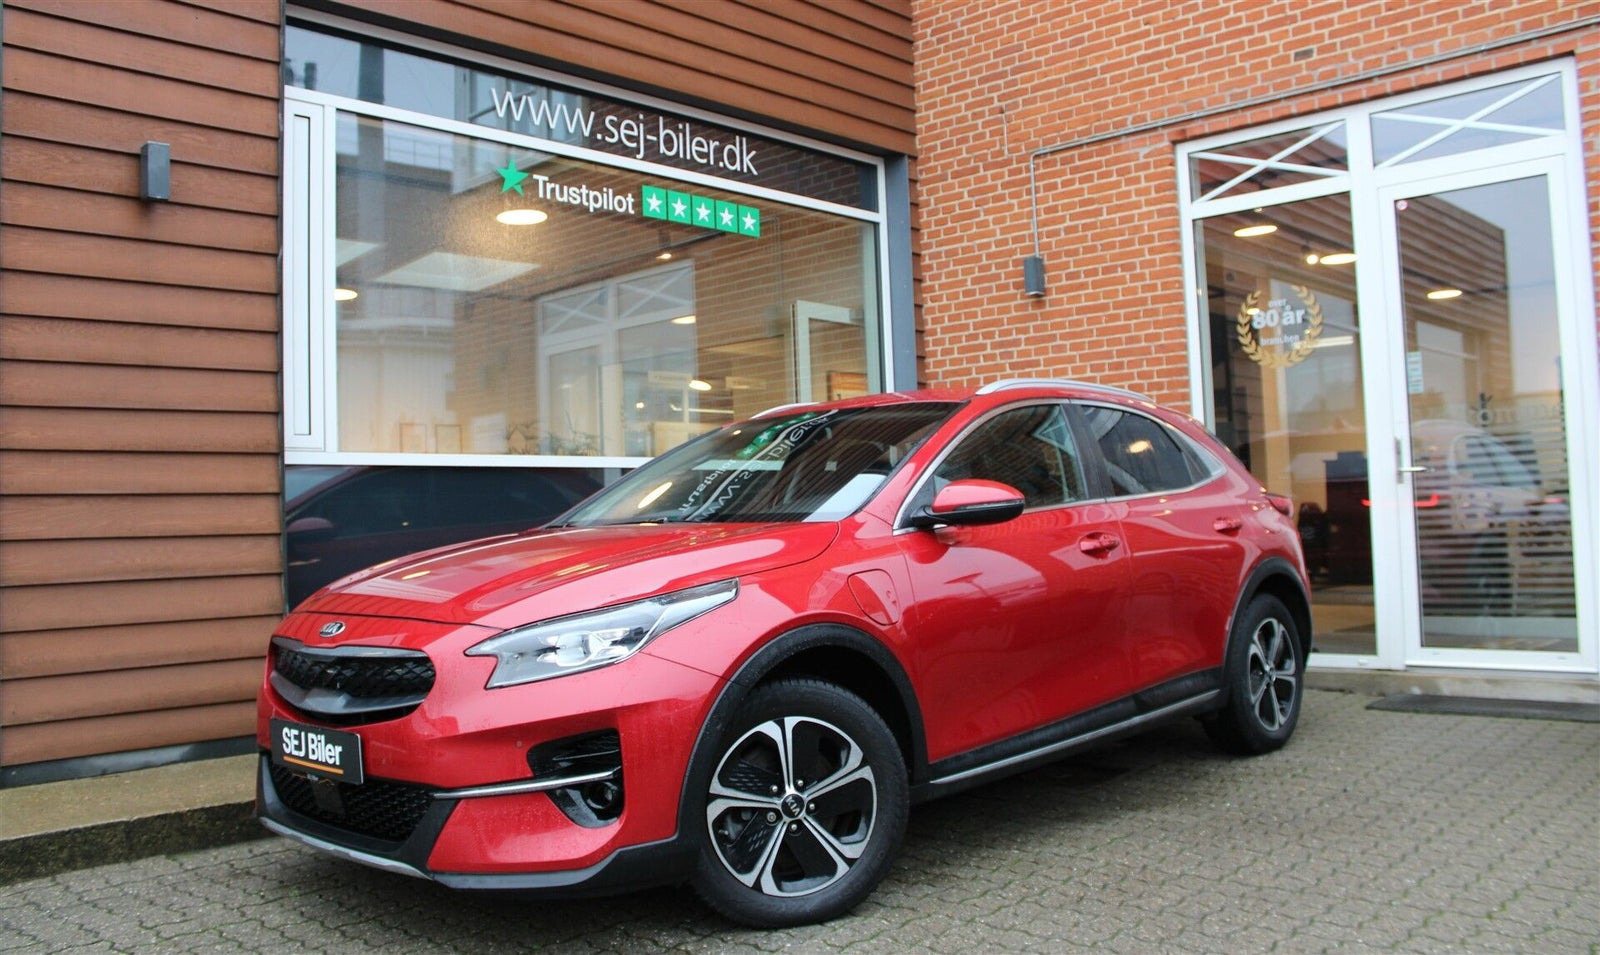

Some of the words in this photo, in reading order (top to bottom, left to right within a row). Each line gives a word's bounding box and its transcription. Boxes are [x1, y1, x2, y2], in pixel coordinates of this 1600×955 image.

[491, 87, 760, 177] www.sej-biler.dk
[532, 173, 636, 215] Trustpilot
[1252, 308, 1280, 330] 80
[1282, 304, 1306, 326] år
[282, 726, 306, 758] SEJ
[307, 731, 343, 766] Biler
[785, 795, 801, 817] KIA
